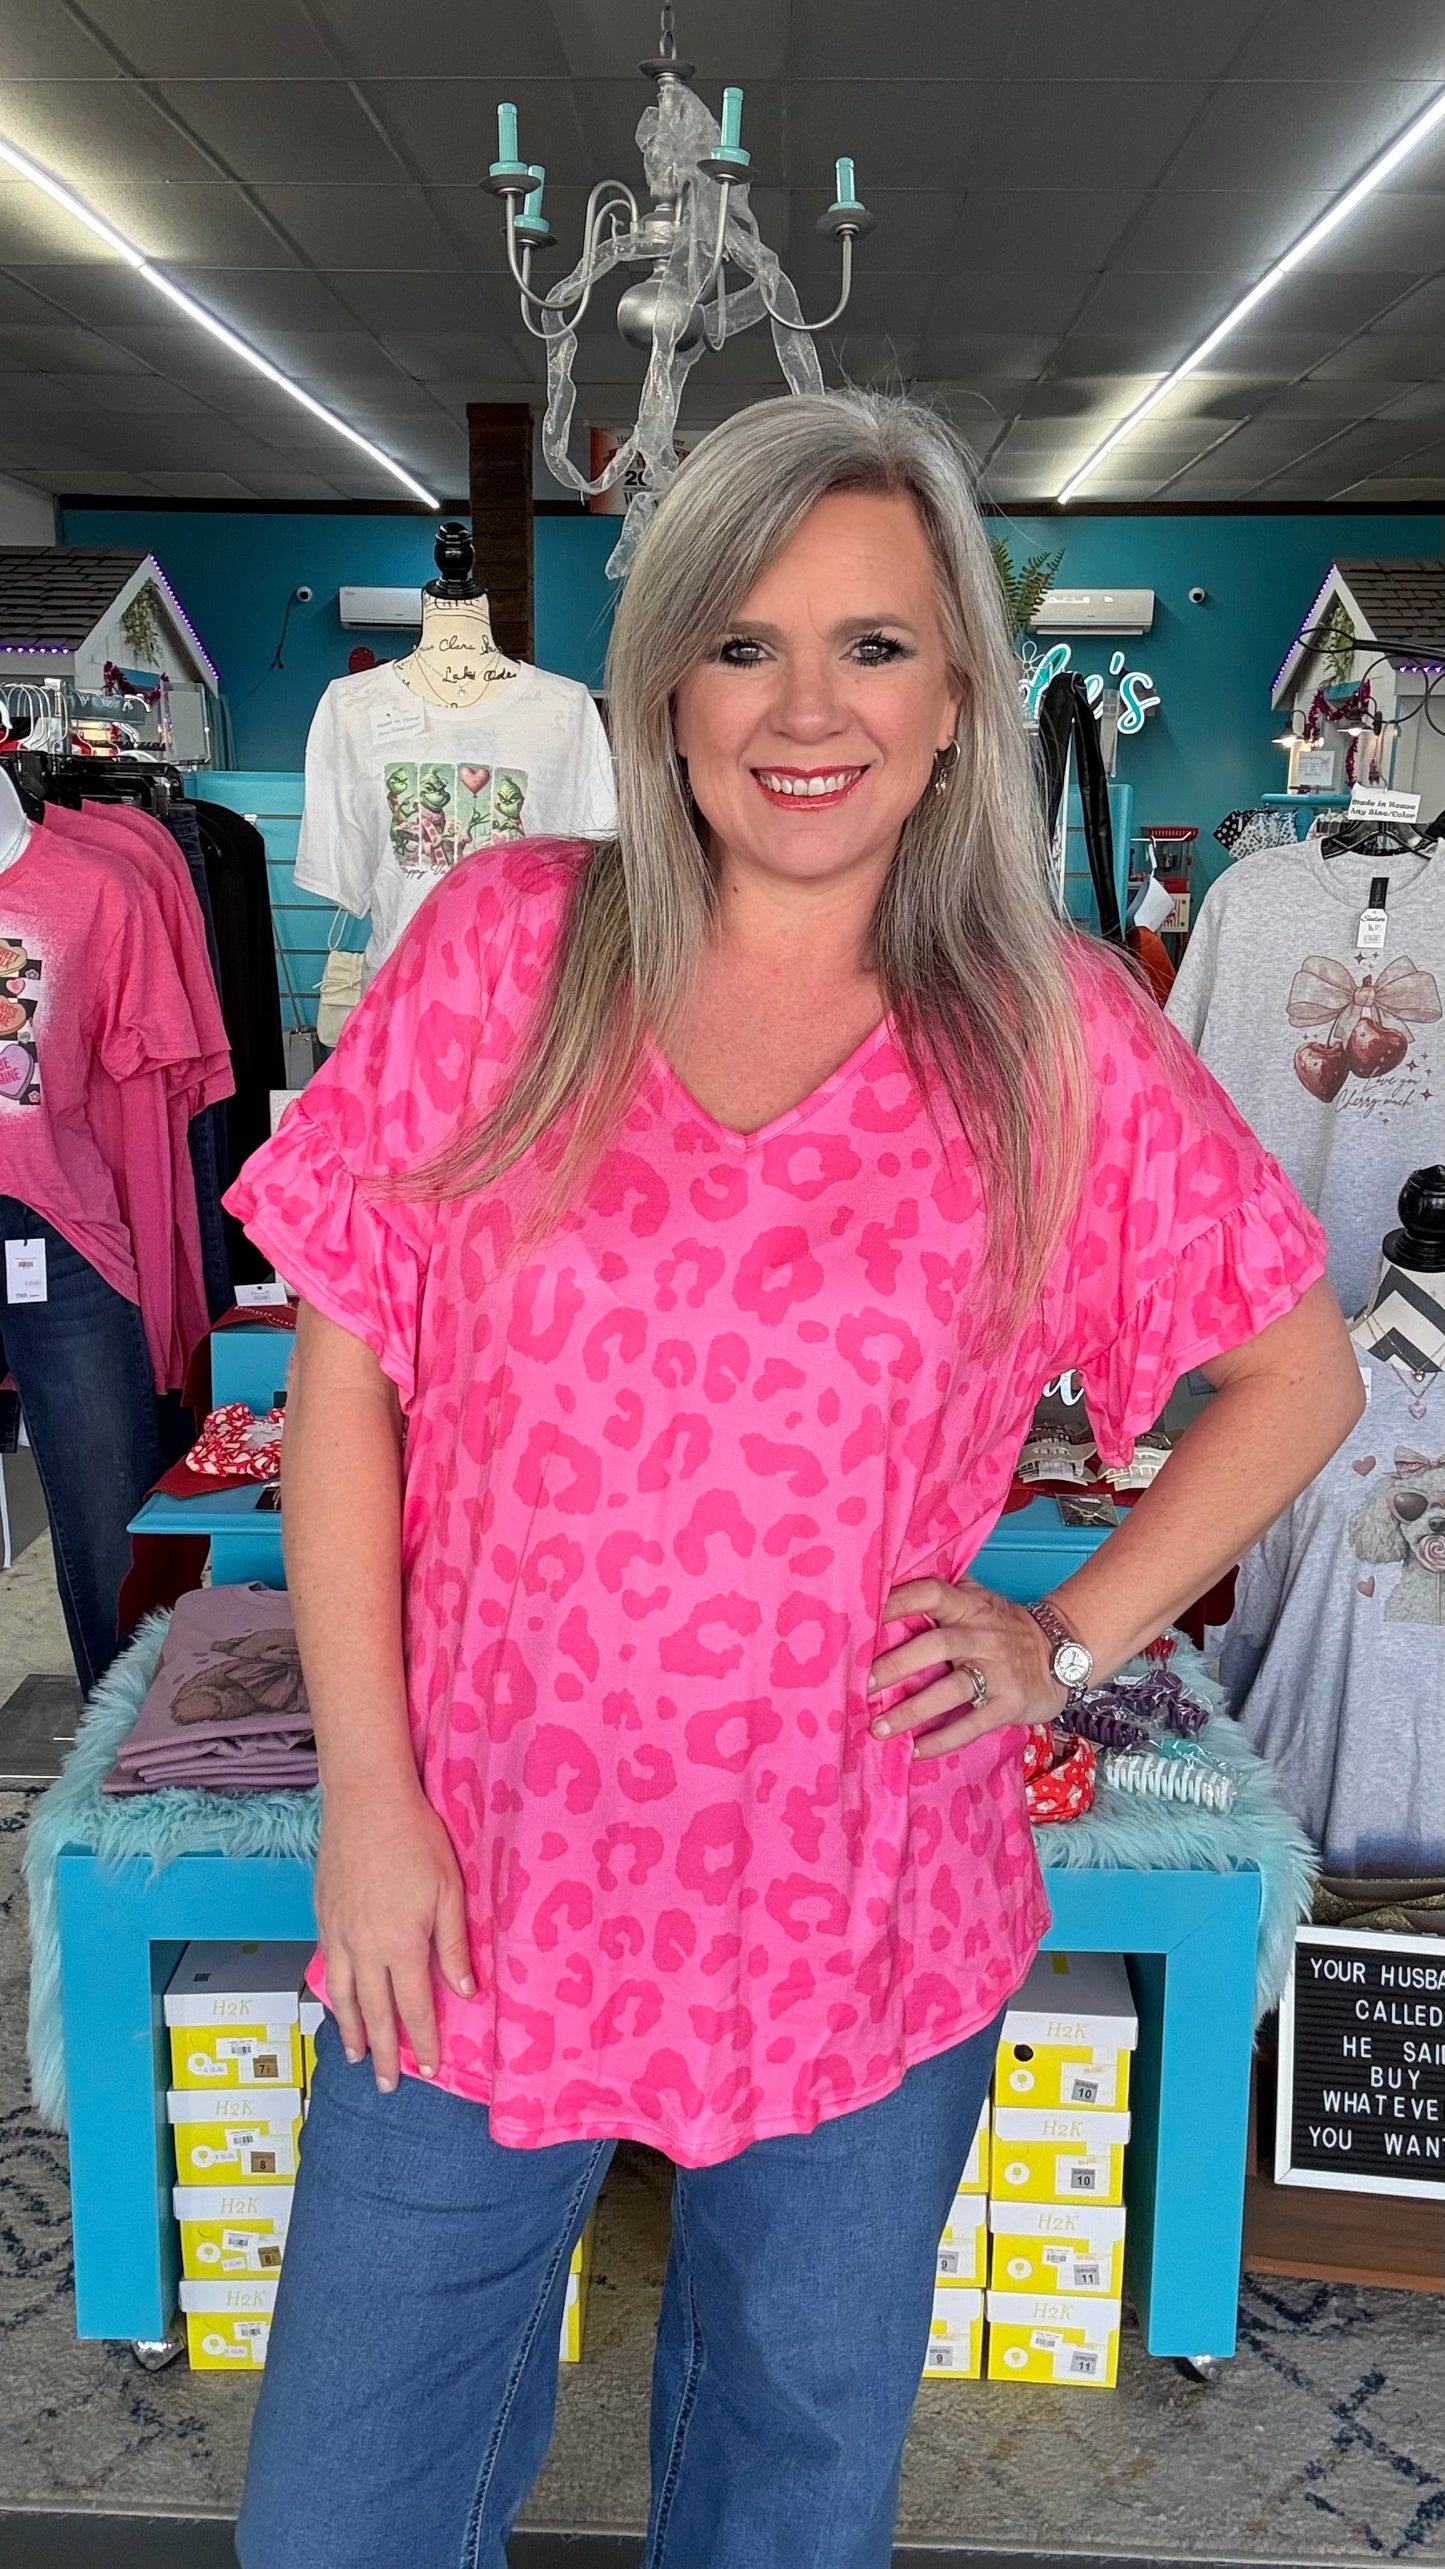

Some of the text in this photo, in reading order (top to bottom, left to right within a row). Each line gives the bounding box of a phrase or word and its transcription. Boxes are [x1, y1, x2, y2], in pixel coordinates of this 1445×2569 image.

[1310, 1957, 1367, 1984] YOUR
[213, 1999, 252, 2016] H2K
[1355, 1999, 1443, 2027] CALLED
[1046, 2021, 1088, 2039] H2K
[1342, 2034, 1373, 2059] HE
[1370, 2065, 1421, 2091] BUY
[1078, 2087, 1092, 2099] 10
[214, 2099, 253, 2116] H2K
[1323, 2089, 1439, 2121] WHATEVE
[1042, 2119, 1084, 2137] H2K
[1309, 2125, 1352, 2151] YOU
[1077, 2176, 1091, 2186] 10
[222, 2197, 258, 2214] H2K
[1038, 2213, 1079, 2231] H2K
[941, 2259, 948, 2271] 9
[1081, 2273, 1094, 2283] 11
[227, 2290, 265, 2307] H2K
[1033, 2302, 1074, 2320] H2K
[1078, 2361, 1091, 2371] 11
